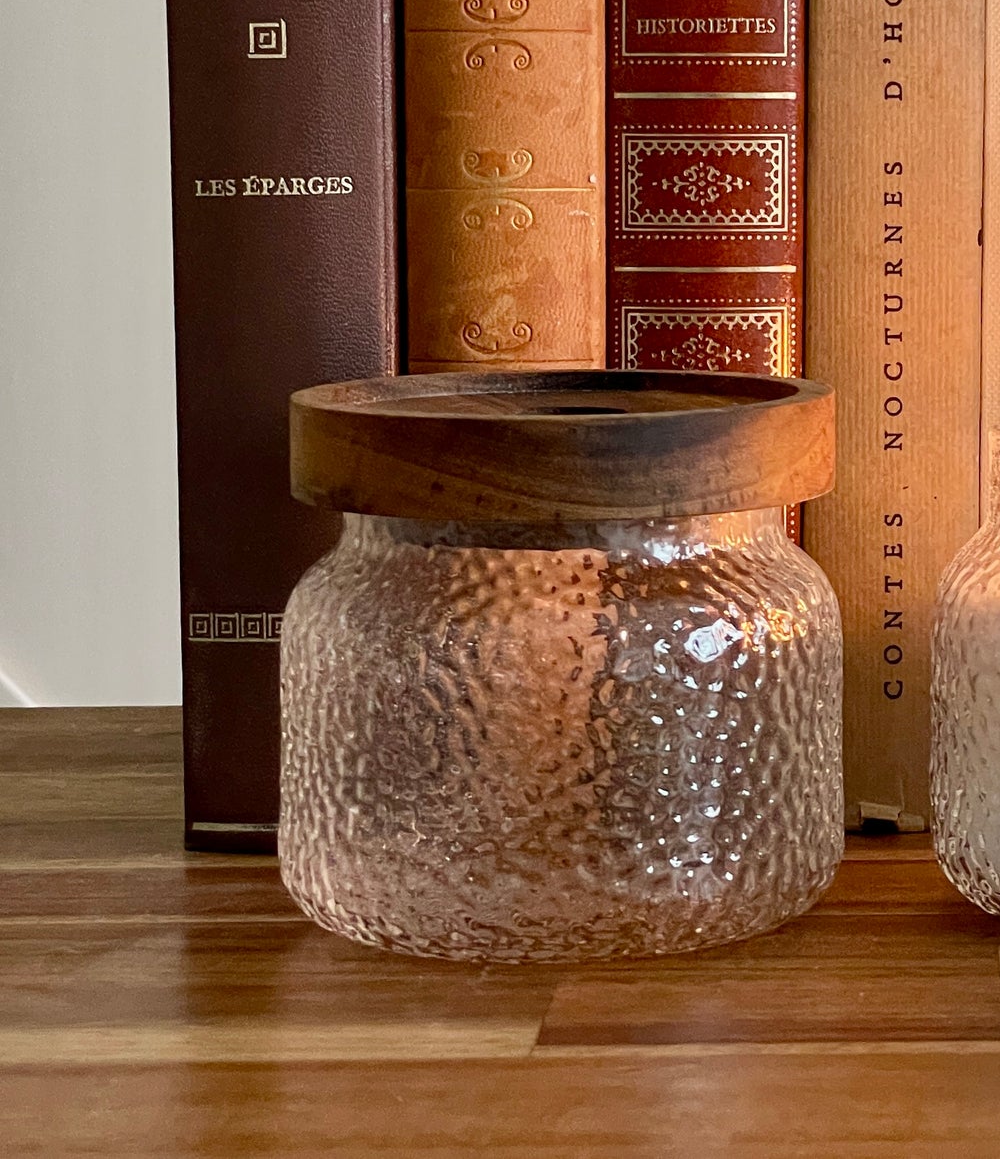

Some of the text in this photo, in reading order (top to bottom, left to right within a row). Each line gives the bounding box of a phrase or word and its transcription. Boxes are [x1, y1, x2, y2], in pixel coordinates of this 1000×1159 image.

[636, 17, 777, 35] HISTORIETTES
[194, 175, 354, 197] LES ÉPARGES
[883, 160, 904, 451] NOCTURNES
[883, 512, 904, 700] CONTES
